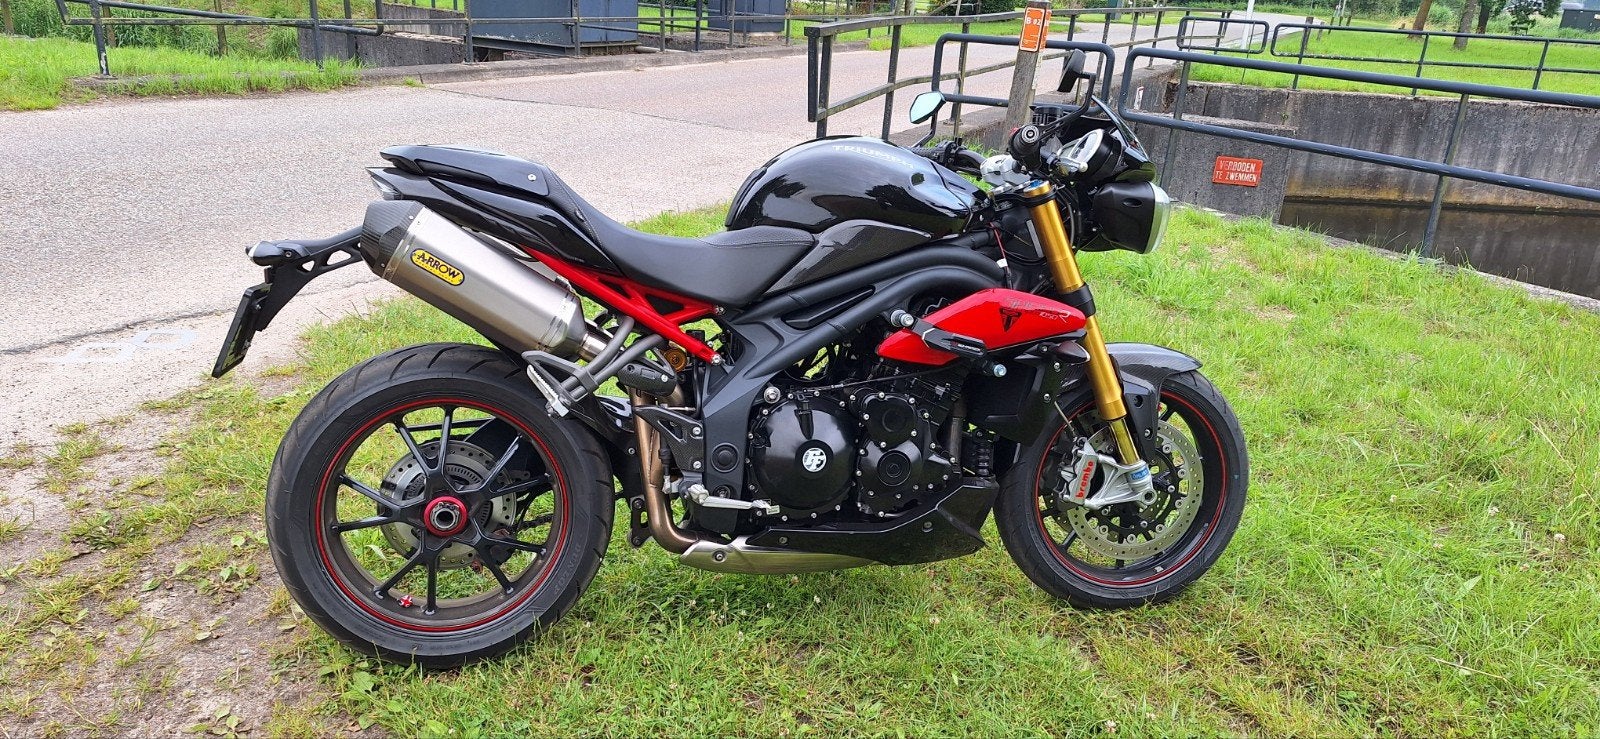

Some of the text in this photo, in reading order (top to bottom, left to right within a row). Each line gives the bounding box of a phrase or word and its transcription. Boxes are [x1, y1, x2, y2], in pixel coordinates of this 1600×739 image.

[1219, 160, 1256, 172] VERBODEN
[1215, 170, 1258, 183] TE ZWEMMEN
[416, 252, 460, 279] ARROW
[1076, 460, 1094, 498] brembo
